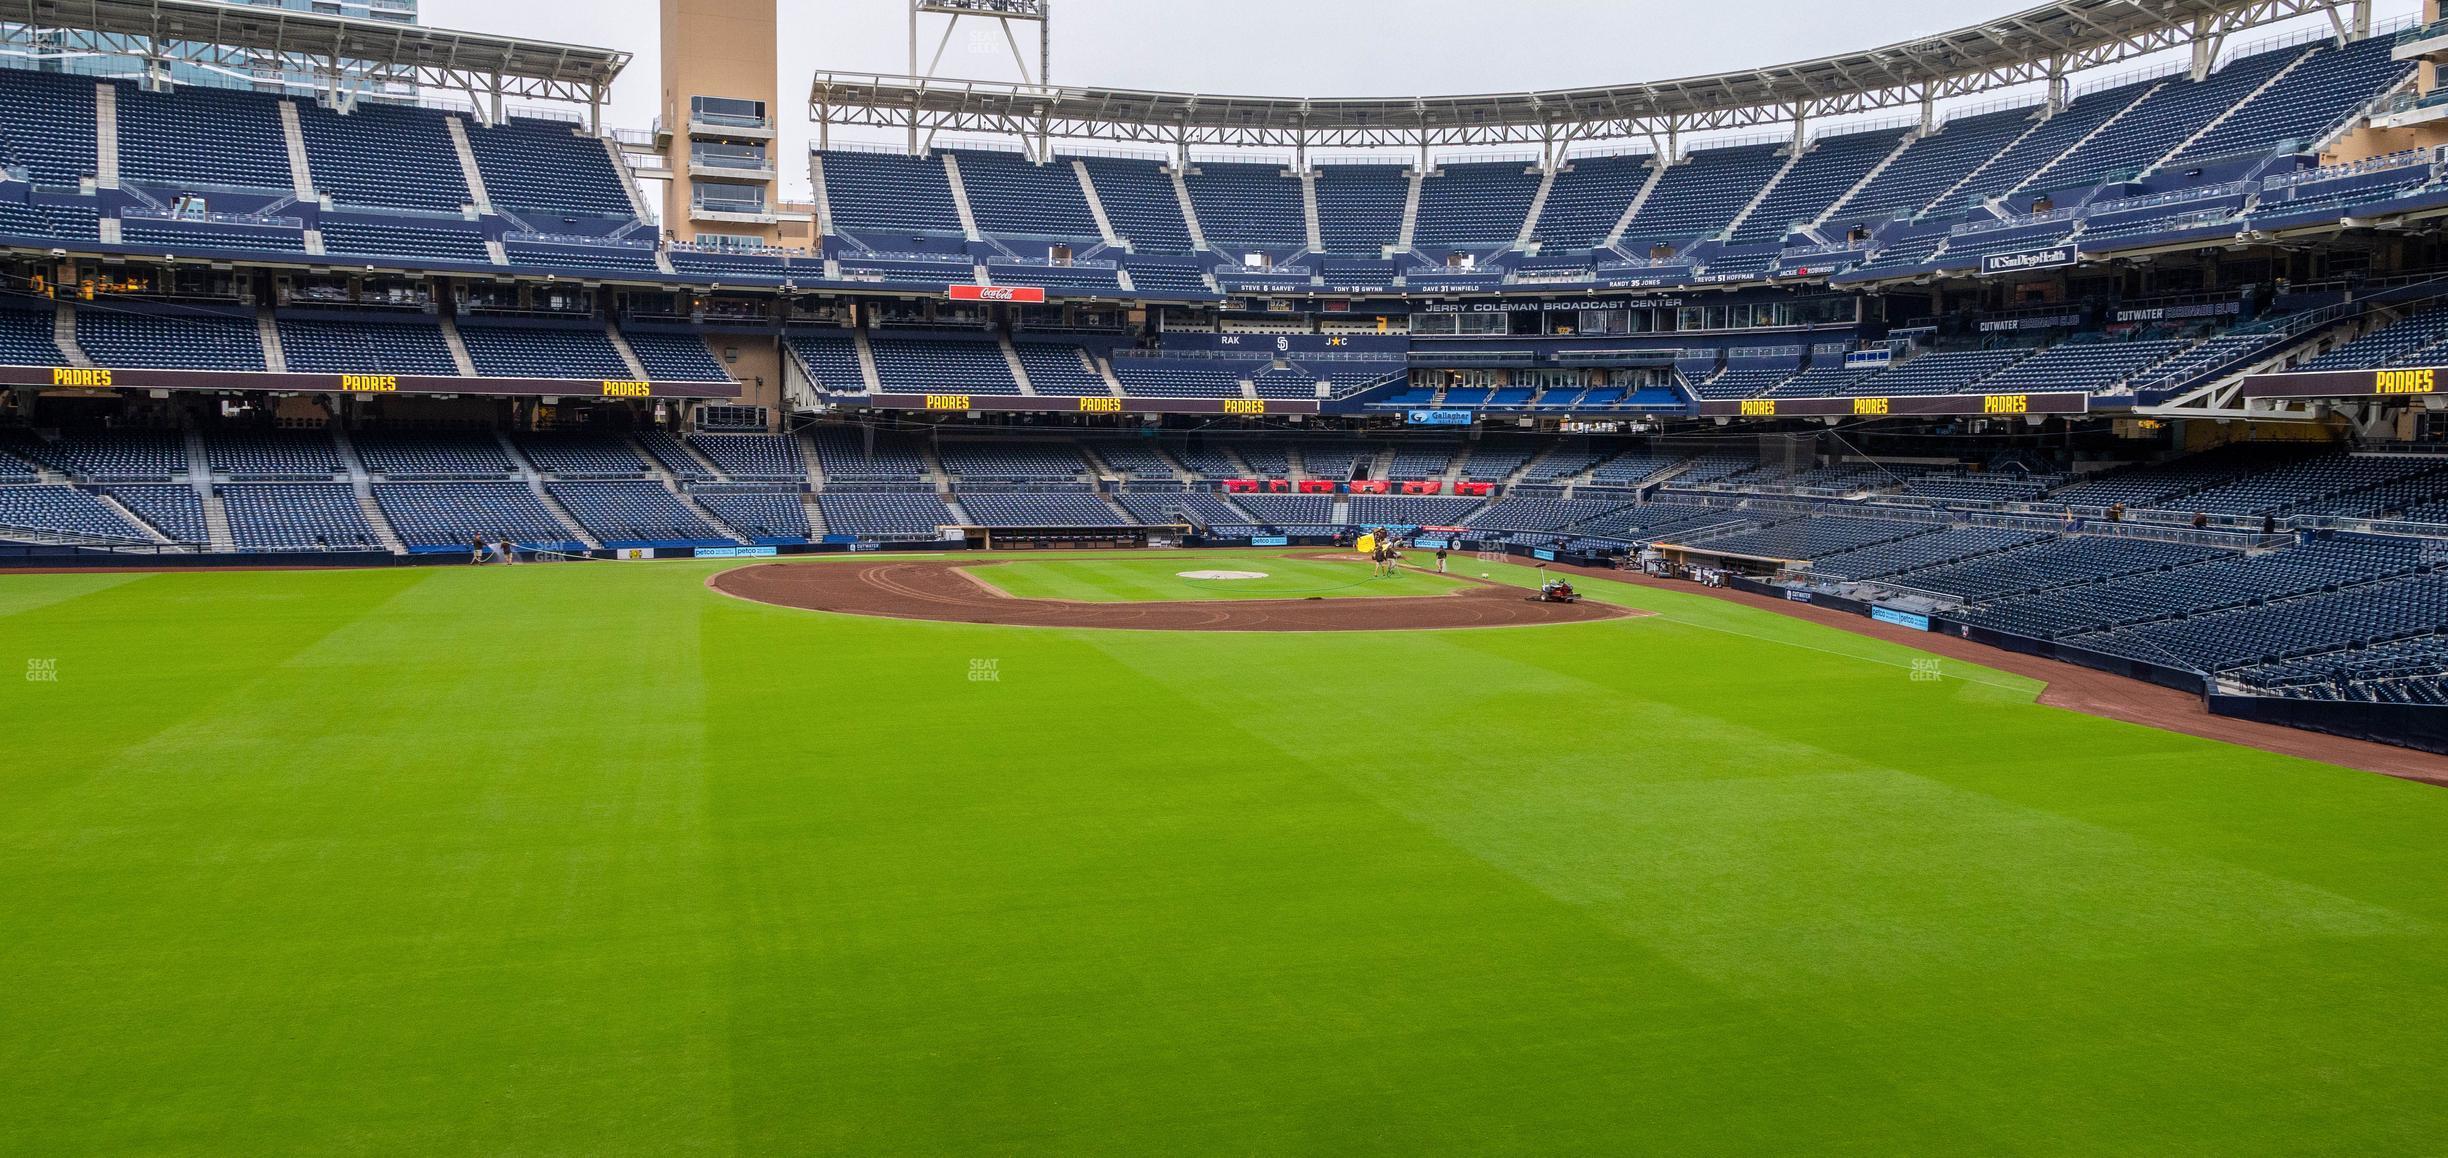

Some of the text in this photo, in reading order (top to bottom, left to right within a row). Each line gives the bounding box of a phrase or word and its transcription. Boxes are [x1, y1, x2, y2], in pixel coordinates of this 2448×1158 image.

[1808, 266, 1835, 274] ROBINSON
[1630, 279, 1640, 287] 35
[1726, 273, 1755, 281] HOFFMAN
[981, 287, 1015, 300] Coca-Cola
[1440, 285, 1449, 293] 31
[1425, 298, 1682, 312] JERRY COLEMAN BROADCAST CENTER
[2116, 308, 2163, 321] CUTWATER
[1980, 319, 2018, 332] CUTWATER
[1221, 336, 1240, 344] RAK
[54, 368, 112, 386] PADRES
[342, 375, 397, 391] PADRES
[2375, 369, 2435, 394] PADRES
[603, 381, 650, 396] PADRES
[927, 395, 969, 409] PADRES
[1080, 397, 1121, 411] PADRES
[1224, 399, 1265, 414] PADRES
[1741, 400, 1775, 415] PADRES
[1854, 398, 1888, 414] PADRES
[1983, 395, 2027, 413] PADRES
[1432, 411, 1469, 420] Gallagher
[1872, 608, 1886, 617] petco
[1900, 614, 1914, 624] petco
